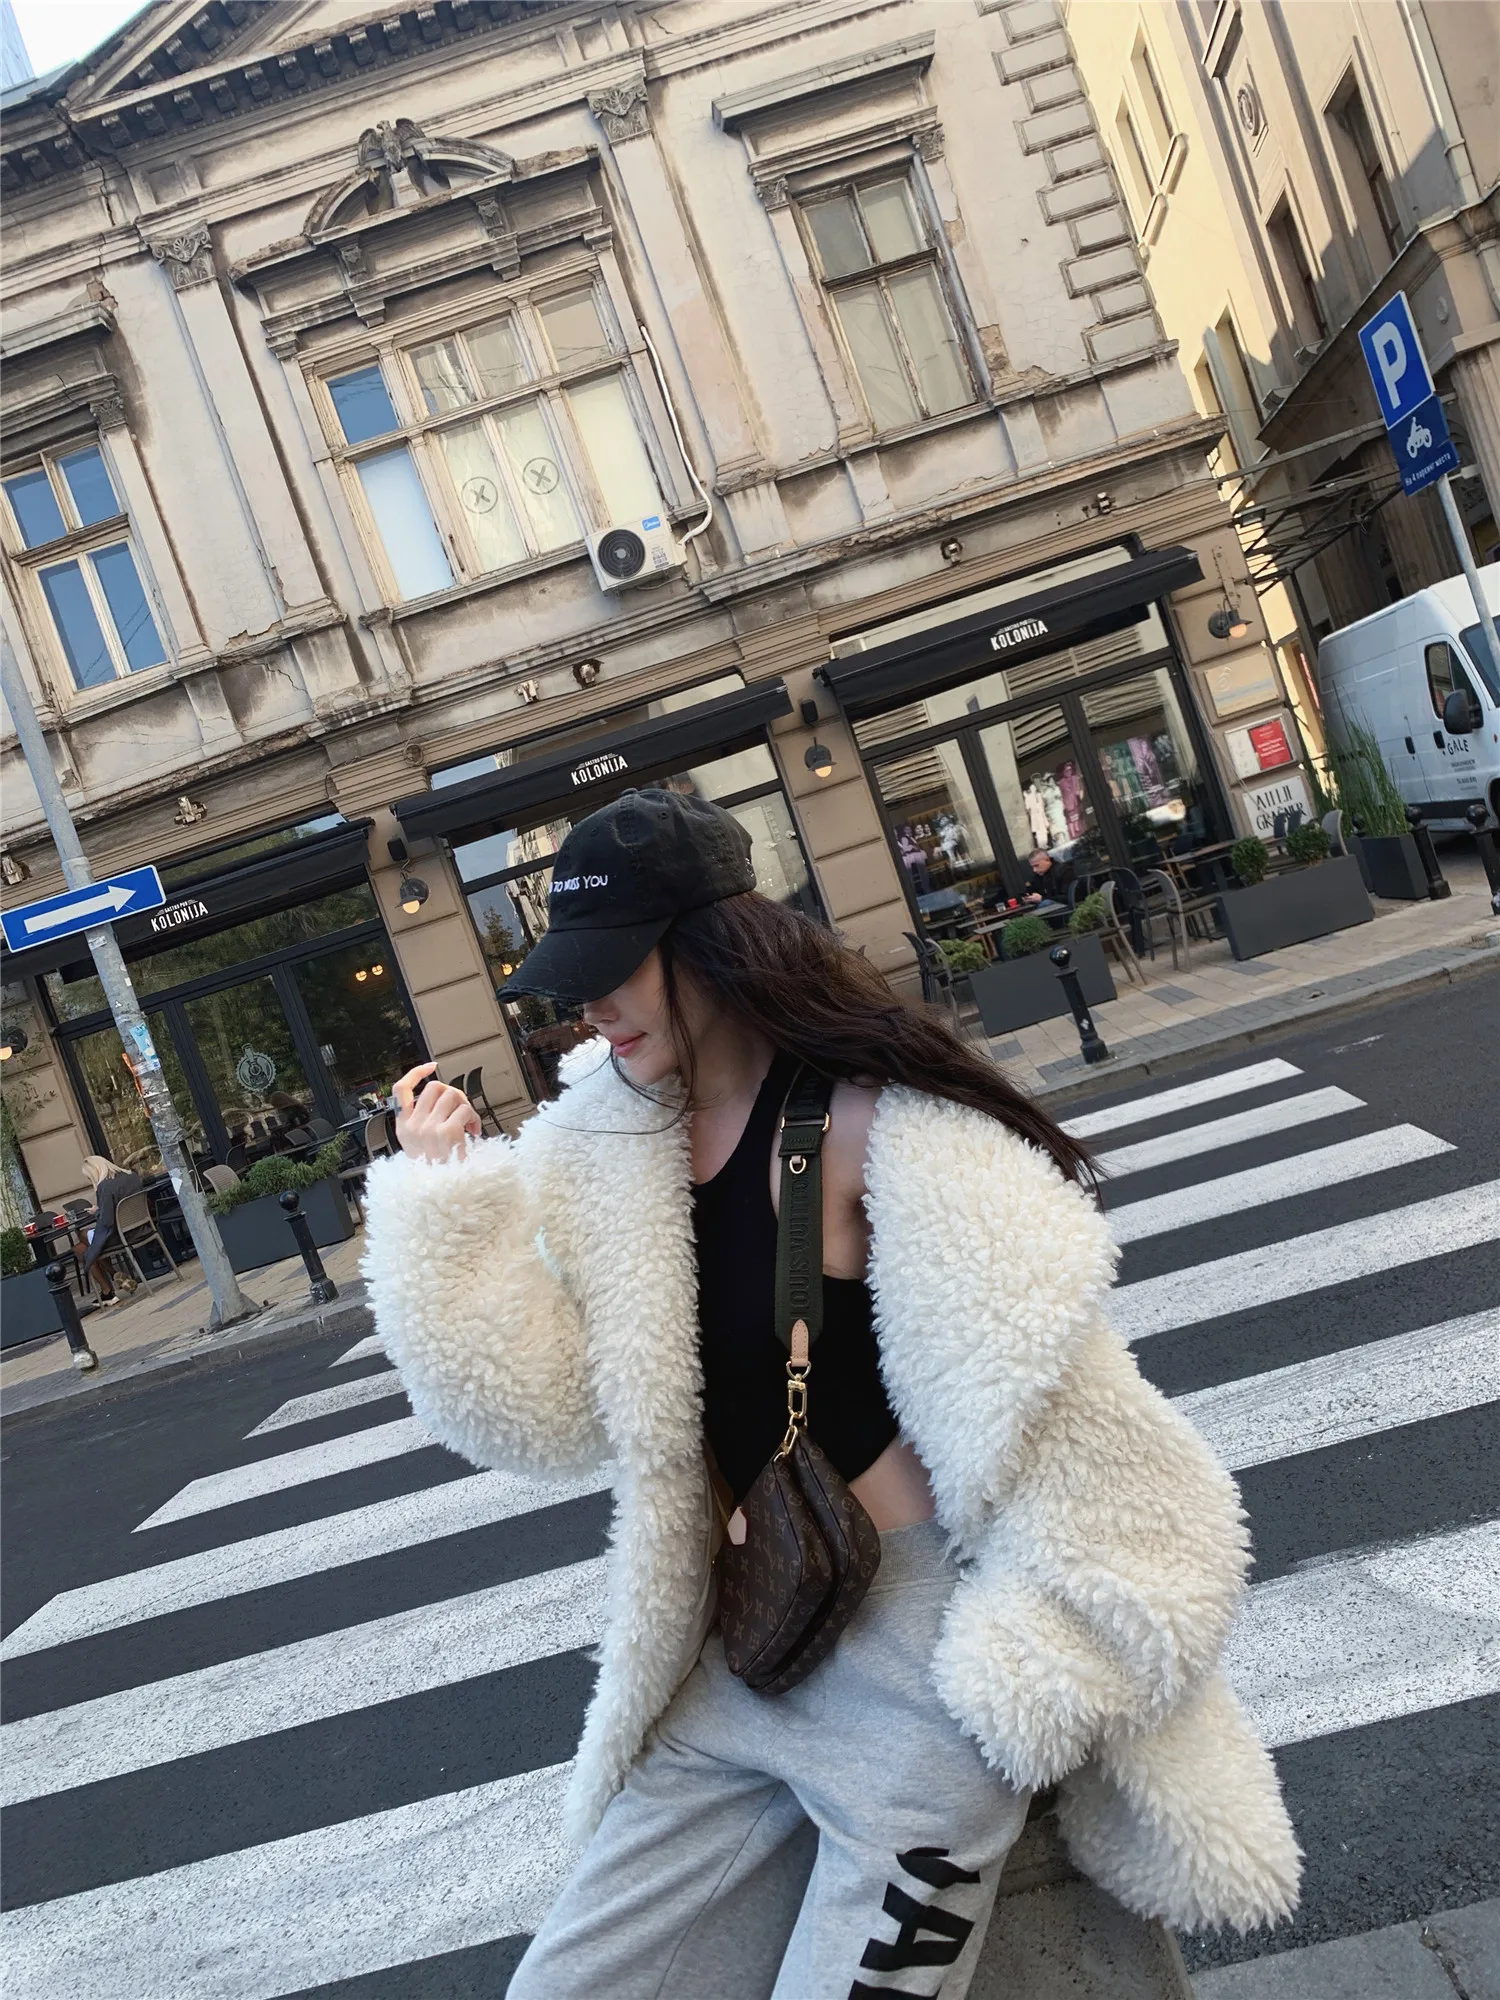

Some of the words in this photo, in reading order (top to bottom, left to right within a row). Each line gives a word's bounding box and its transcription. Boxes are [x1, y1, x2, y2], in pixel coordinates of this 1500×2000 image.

[1371, 321, 1407, 410] P
[990, 620, 1049, 651] KOLONIJA
[1447, 738, 1469, 755] GALE
[570, 755, 629, 786] KOLONIJA
[583, 874, 608, 889] YOU
[150, 901, 209, 932] KOLONIJA
